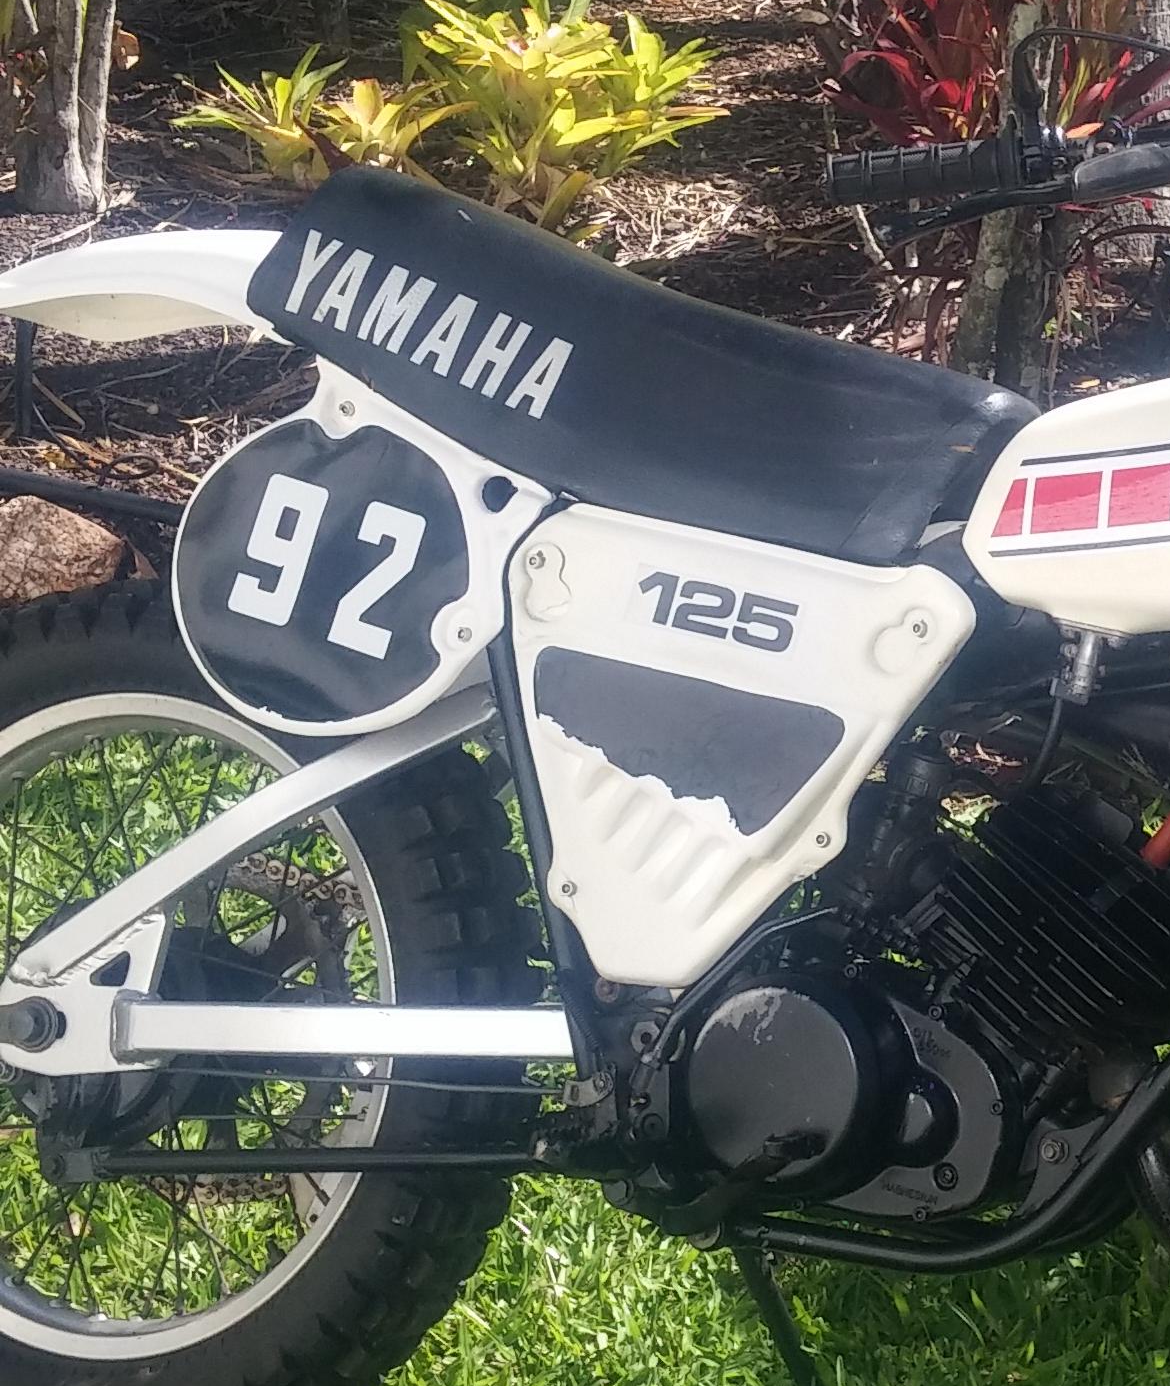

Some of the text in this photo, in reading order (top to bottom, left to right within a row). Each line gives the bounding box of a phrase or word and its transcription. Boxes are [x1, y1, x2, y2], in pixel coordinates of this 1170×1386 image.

[285, 229, 574, 419] YAMAHA
[227, 473, 427, 660] 92
[638, 571, 799, 653] 125
